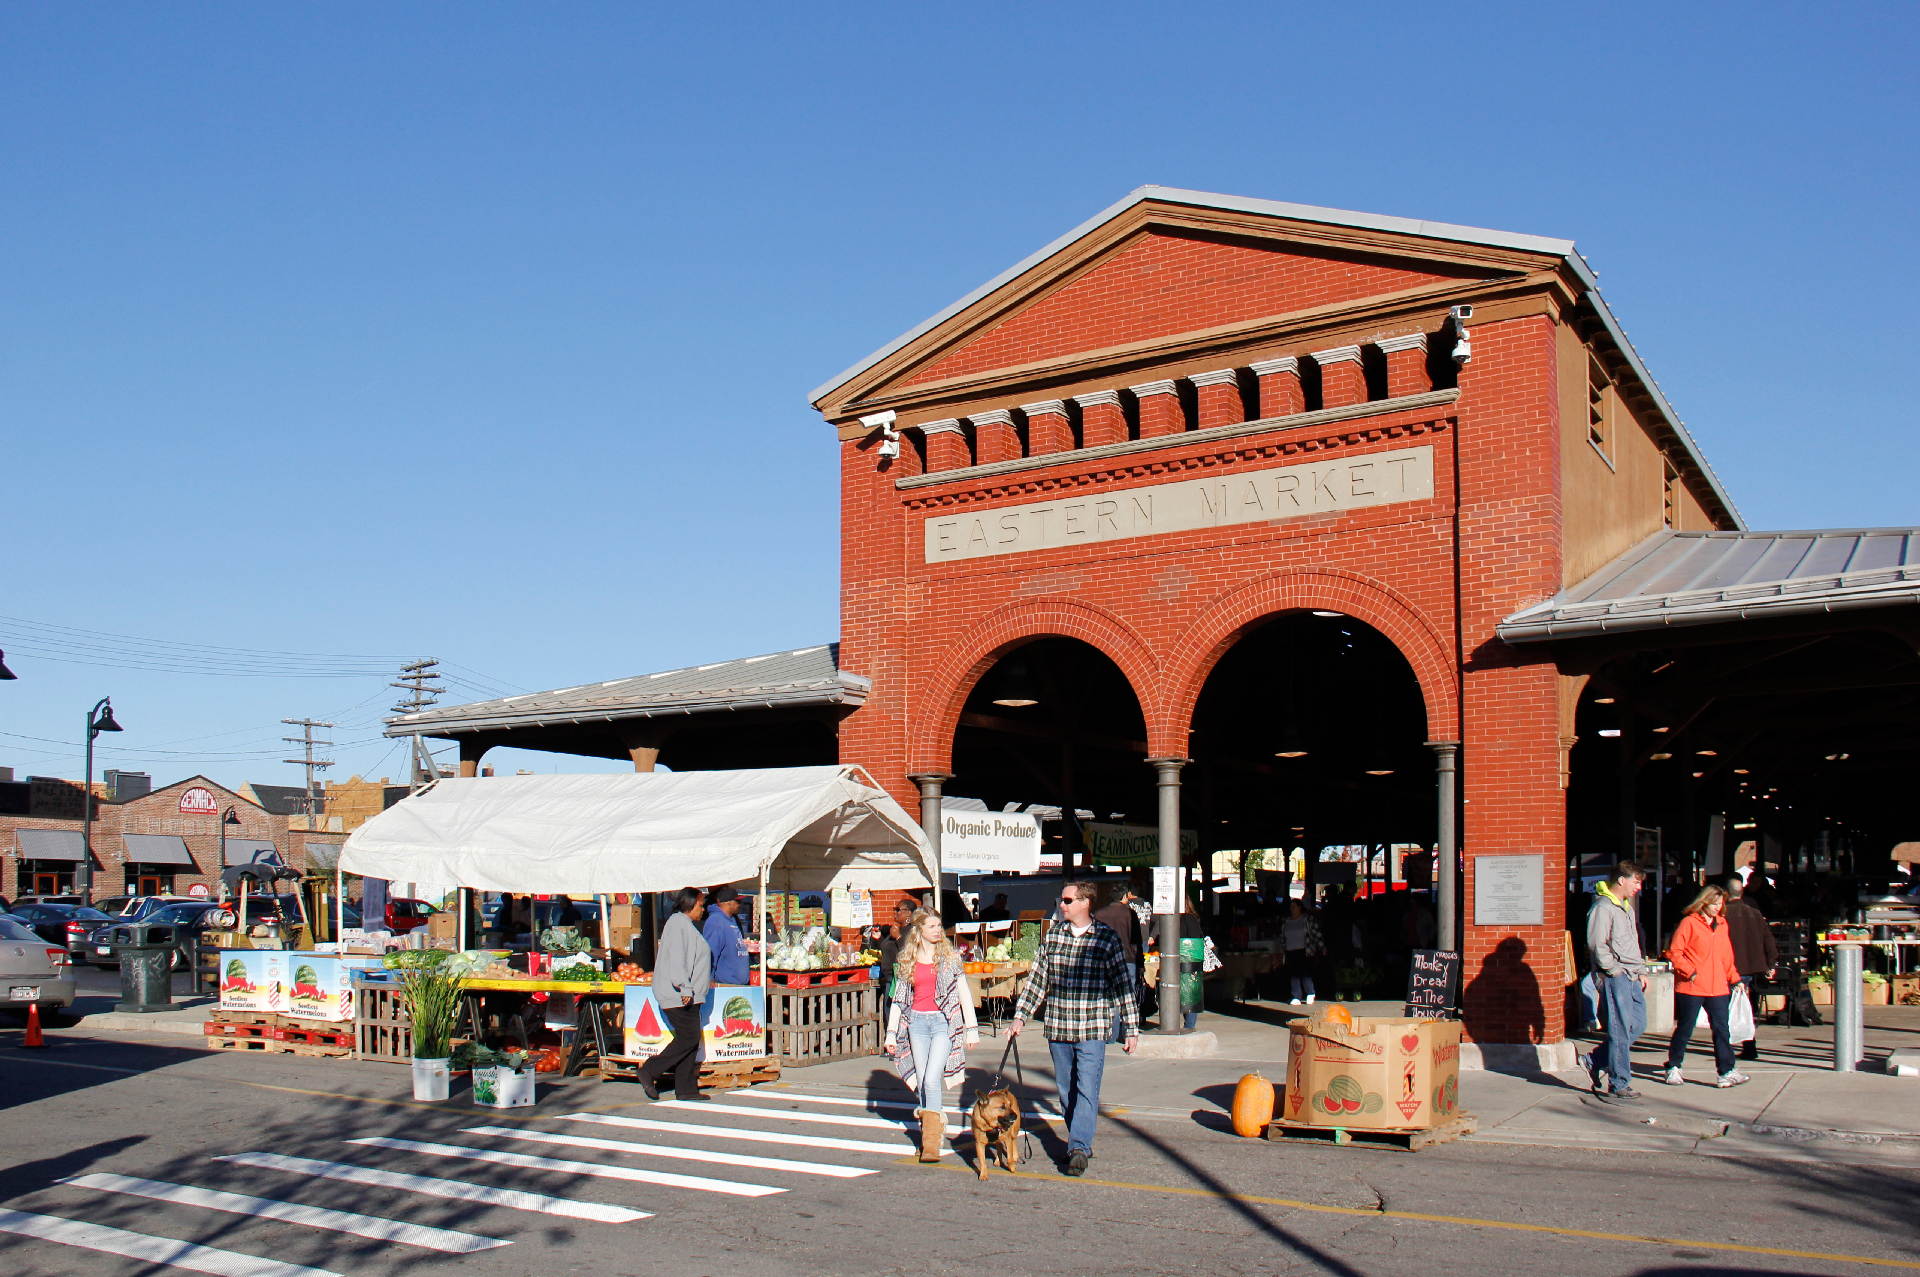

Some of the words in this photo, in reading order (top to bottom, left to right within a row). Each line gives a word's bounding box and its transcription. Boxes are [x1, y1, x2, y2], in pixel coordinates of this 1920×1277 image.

[937, 495, 1153, 553] EASTERN
[1199, 456, 1418, 517] MARKET
[180, 788, 217, 810] GERMACK
[946, 816, 991, 839] Organic
[994, 819, 1037, 839] Produce
[1090, 830, 1159, 858] LEAMINGTON
[981, 853, 1000, 862] Organics
[1414, 953, 1450, 979] Monkey
[1413, 973, 1448, 988] Bread
[1410, 990, 1423, 1004] In
[1423, 988, 1445, 1005] The
[222, 1001, 257, 1009] Watermelons
[290, 1007, 327, 1018] Watermelons
[297, 1002, 319, 1010] Seedless
[715, 1047, 763, 1058] Watermelons
[727, 1041, 753, 1050] Seedless
